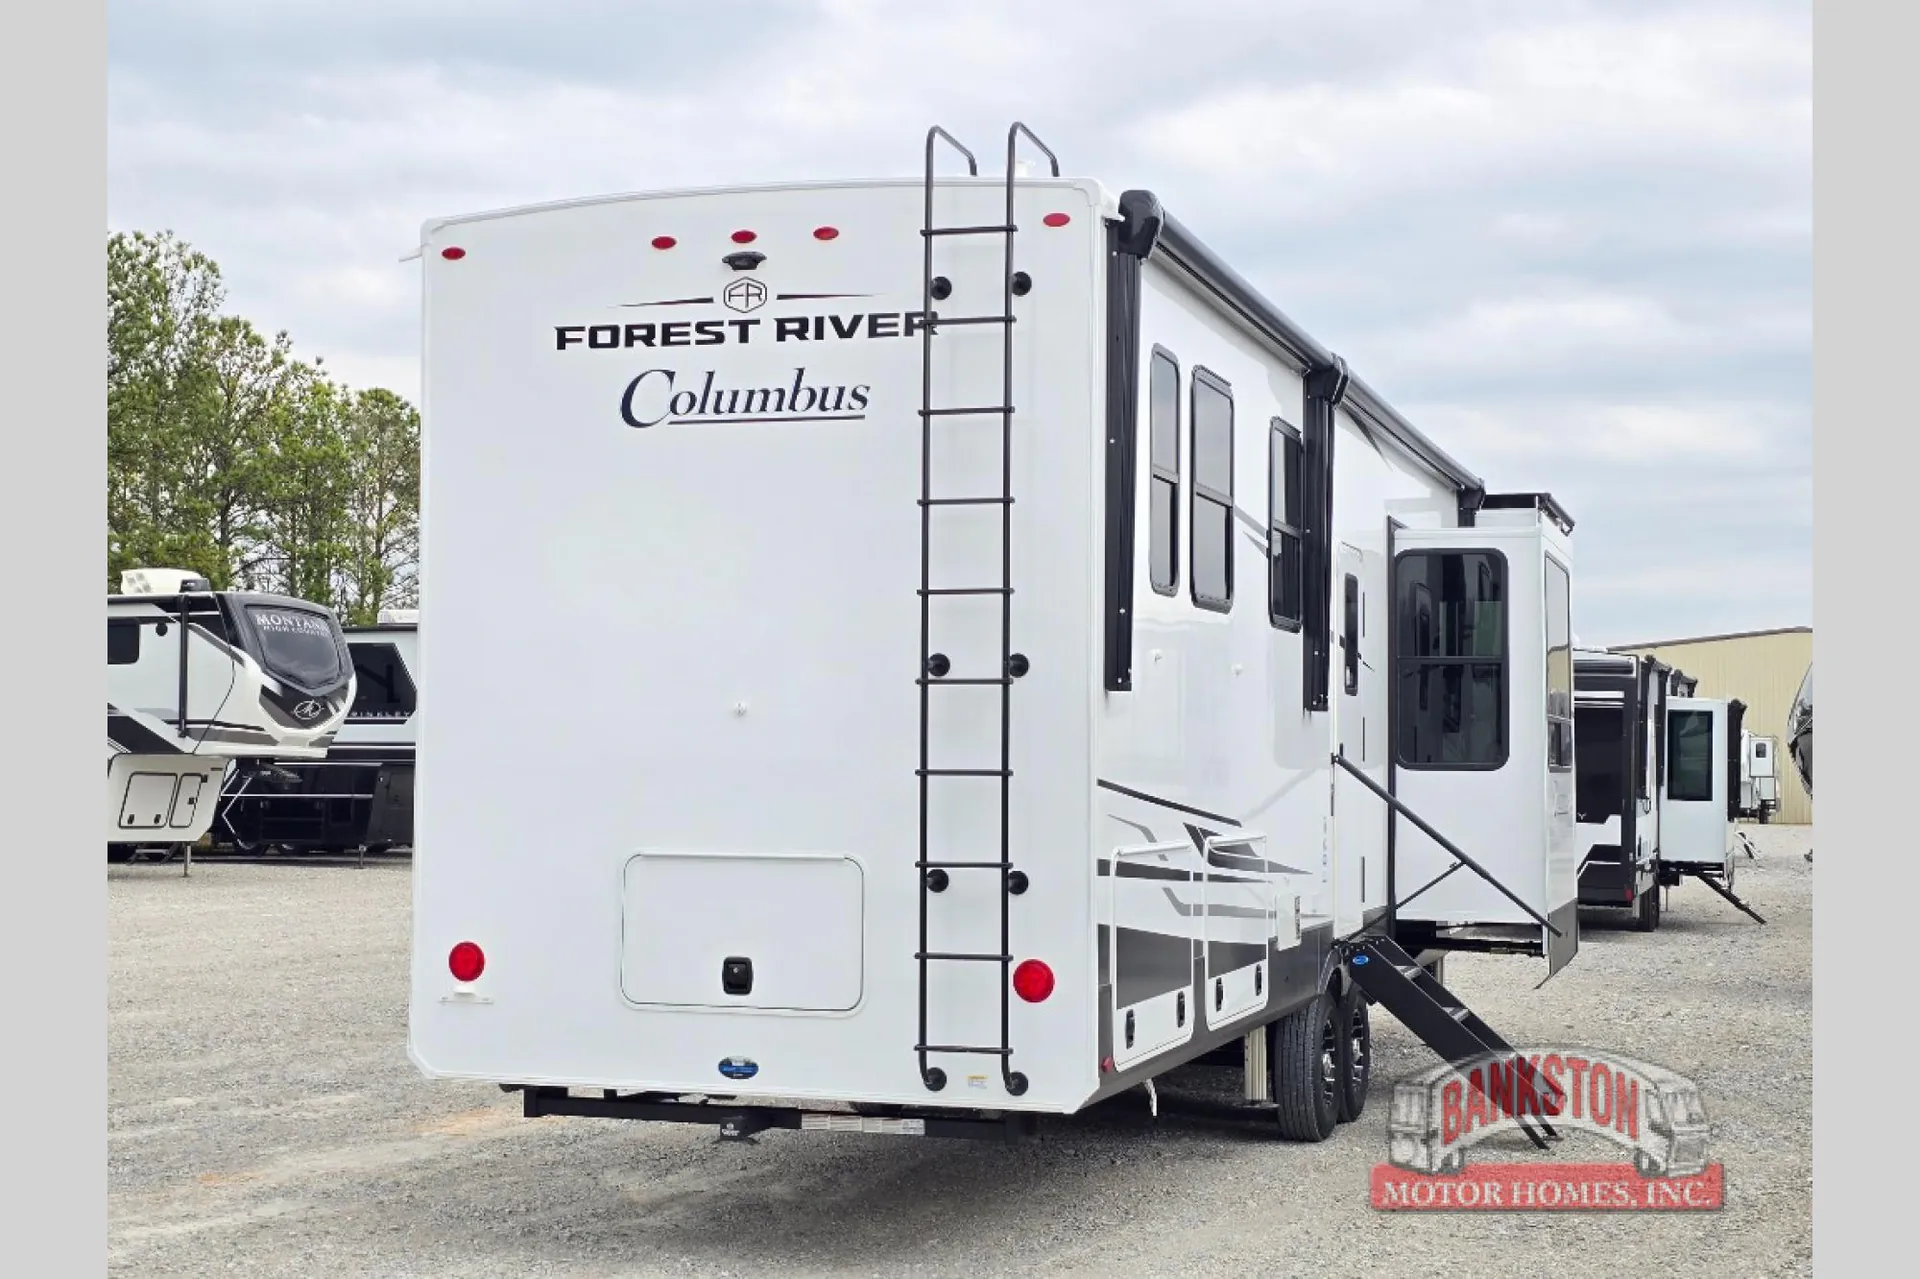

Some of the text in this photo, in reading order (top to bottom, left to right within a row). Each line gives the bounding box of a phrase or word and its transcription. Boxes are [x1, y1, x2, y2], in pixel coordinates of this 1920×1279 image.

[554, 310, 939, 350] FOREST RIVER
[620, 367, 870, 428] Columbus
